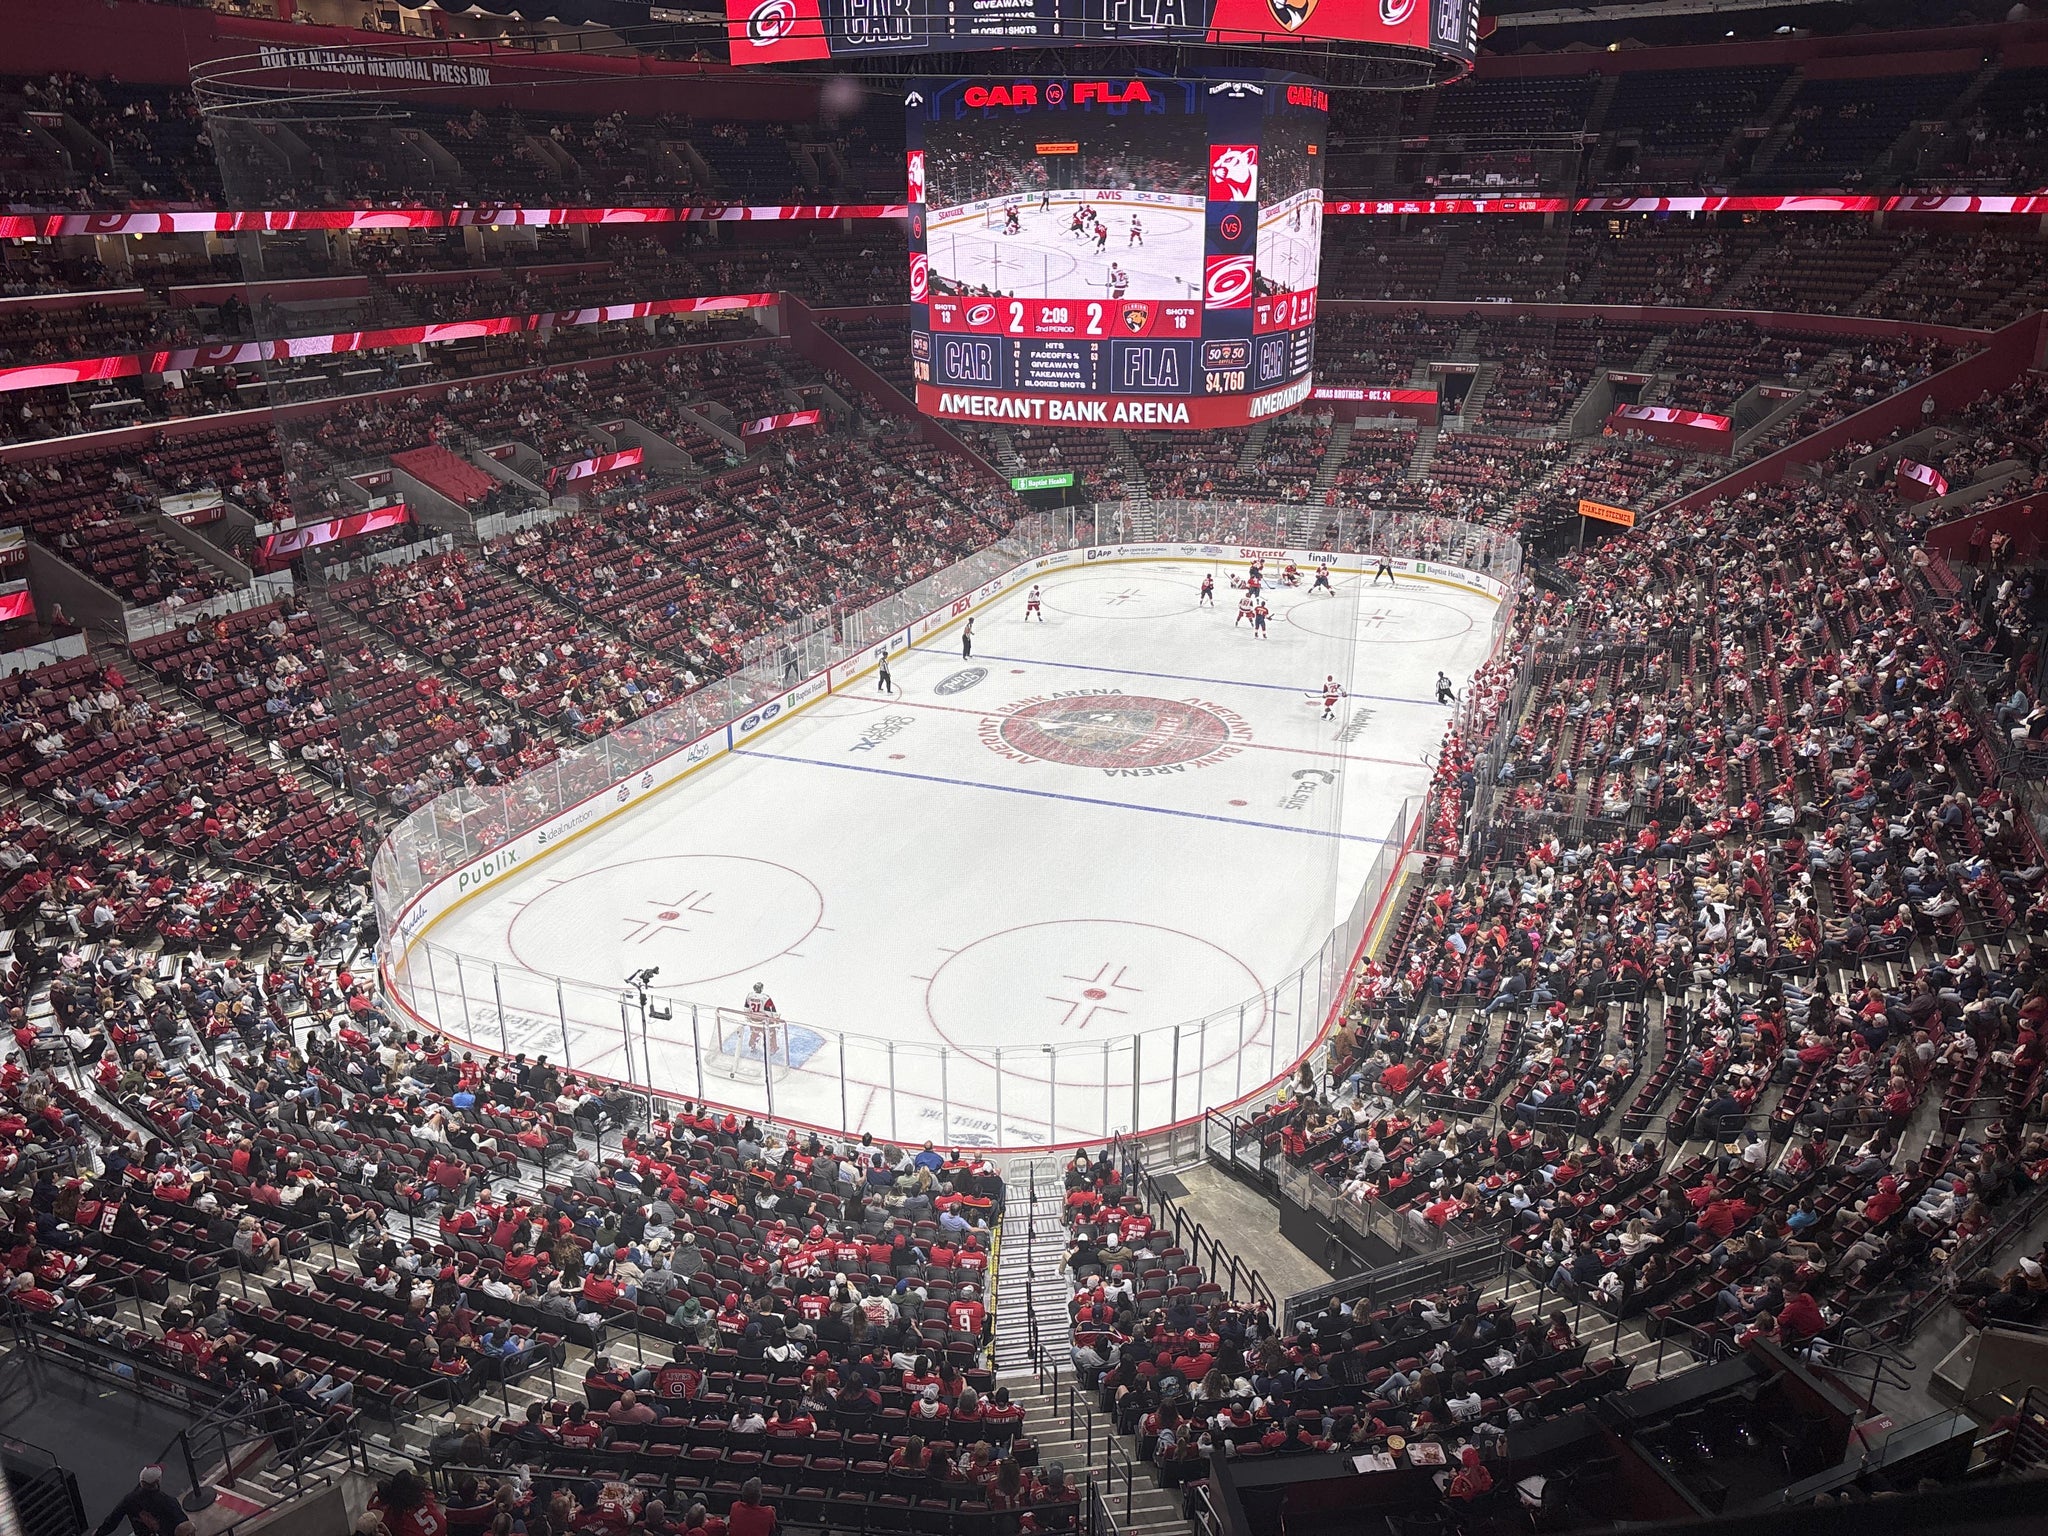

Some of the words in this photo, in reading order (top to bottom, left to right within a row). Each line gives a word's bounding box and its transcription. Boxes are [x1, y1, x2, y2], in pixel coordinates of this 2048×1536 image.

[1008, 25, 1038, 35] SHOTS
[309, 51, 365, 75] NEILSON
[367, 57, 431, 81] MEMORIAL
[432, 63, 468, 84] PRESS
[470, 67, 491, 86] BOX
[964, 84, 1037, 107] CAR
[1049, 89, 1060, 99] VS
[1073, 81, 1152, 103] FLA
[1287, 85, 1312, 107] CAR
[1096, 191, 1122, 200] AVIS
[1376, 202, 1393, 213] 2:09
[1223, 222, 1240, 233] VS
[934, 303, 956, 311] SHOTS
[1041, 307, 1068, 324] 2:09
[1009, 301, 1024, 333] 2
[1086, 302, 1102, 335] 2
[1174, 316, 1187, 329] 18
[1045, 342, 1064, 350] HITS
[1208, 349, 1221, 360] 50
[1231, 347, 1245, 358] 50
[945, 341, 992, 381] CAR
[1030, 351, 1072, 359] FACEOFFS
[1260, 340, 1284, 381] CAR
[1031, 361, 1079, 369] GIVEAWAYS
[1124, 347, 1179, 387] FLA
[1030, 371, 1080, 379] TAKEAWAYS
[1205, 371, 1245, 393] $4,760
[1024, 380, 1058, 388] BLOCKED
[1059, 381, 1086, 389] SHOTS
[1249, 385, 1298, 418] AMERANT
[1314, 389, 1333, 399] JONAS
[1334, 390, 1363, 400] BROTHERS
[1383, 391, 1391, 401] 24
[938, 393, 1045, 420] AMERANT
[1048, 398, 1107, 422] BANK
[1113, 400, 1190, 424] ARENA
[1027, 478, 1048, 488] Baptist
[1048, 476, 1067, 486] Health
[210, 507, 222, 519] 117
[1581, 504, 1606, 516] STANLEY
[9, 549, 25, 562] 116
[1308, 552, 1338, 565] finally
[1427, 566, 1447, 576] Baptist
[1447, 568, 1465, 580] Health
[951, 595, 971, 618] DEX
[1051, 688, 1123, 699] ARENA
[995, 694, 1049, 714] BANK
[1181, 697, 1254, 742] AMERANT
[977, 716, 1038, 765] AMERANT
[1187, 746, 1244, 769] BANK
[1103, 763, 1186, 777] ARENA
[1285, 781, 1318, 810] CELSIUS
[458, 850, 517, 892] Publix
[952, 1115, 998, 1133] CRUISE
[959, 1315, 970, 1332] 9
[413, 1505, 438, 1535] 5
